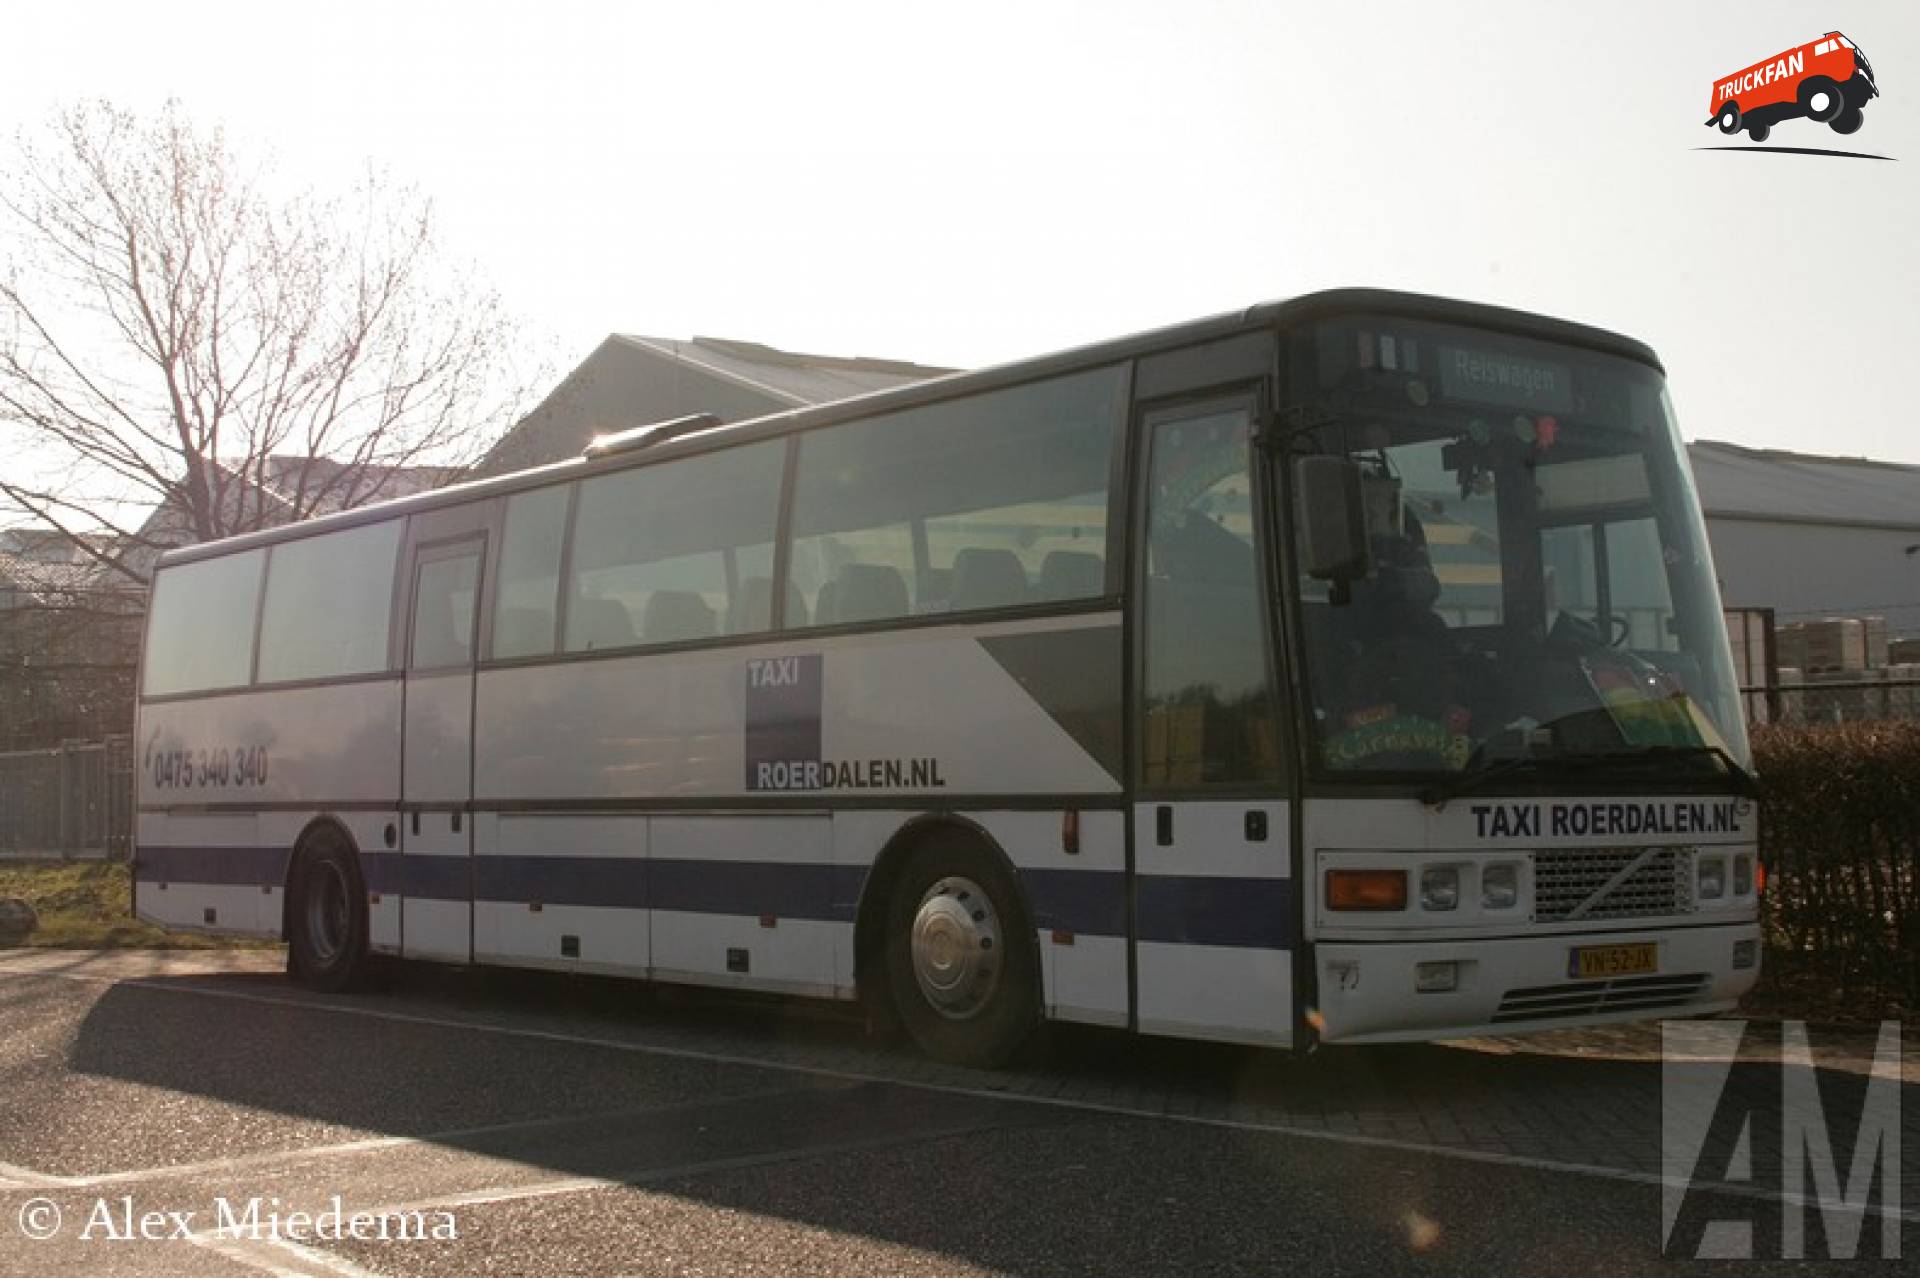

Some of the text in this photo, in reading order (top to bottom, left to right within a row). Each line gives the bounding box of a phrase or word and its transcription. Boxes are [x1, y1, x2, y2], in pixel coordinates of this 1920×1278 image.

[750, 658, 799, 687] TAXI
[155, 745, 269, 788] 0475 340 340
[757, 758, 946, 788] ROERDALEN.NL
[1471, 803, 1741, 837] TAXI ROERDALEN.NL
